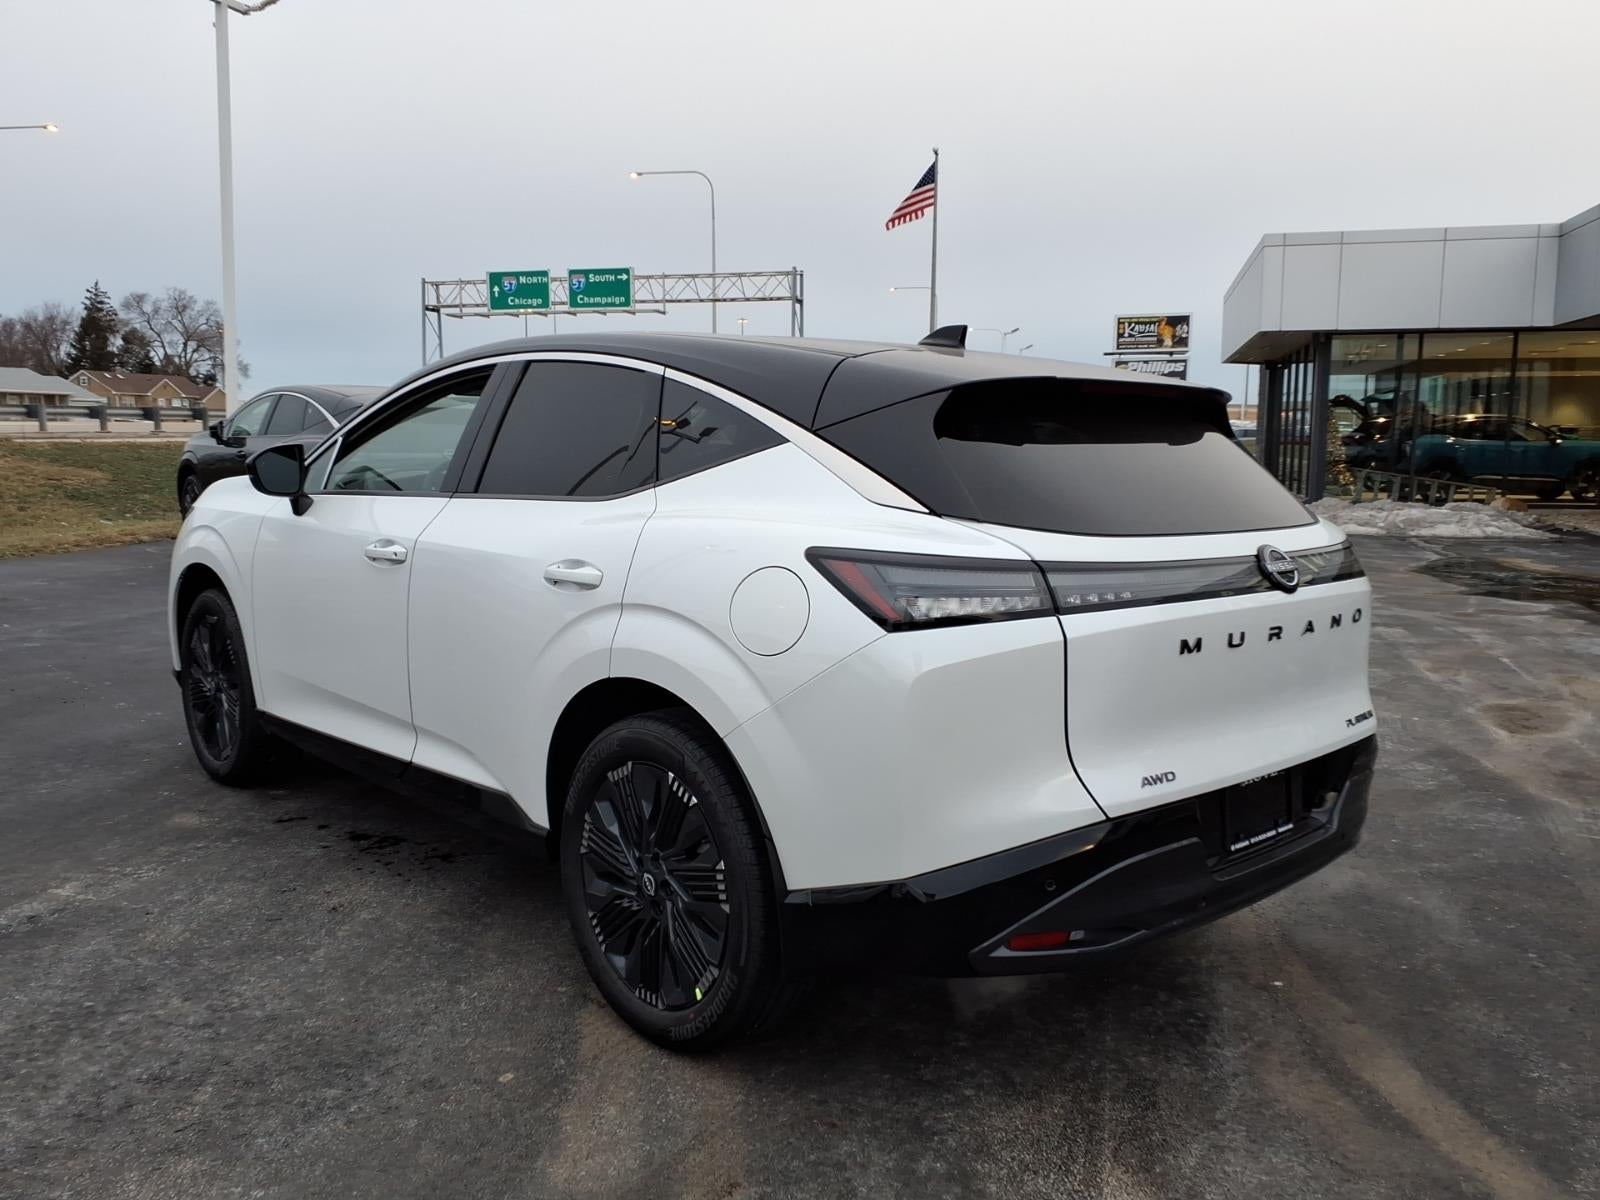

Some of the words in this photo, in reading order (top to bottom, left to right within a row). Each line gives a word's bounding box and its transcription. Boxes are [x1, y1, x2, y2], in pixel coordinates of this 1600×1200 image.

[503, 280, 516, 291] 57
[519, 276, 548, 284] NORTH
[570, 279, 586, 289] 57
[588, 274, 615, 282] SOUTH
[508, 296, 543, 306] Chicago
[577, 294, 626, 305] Champaign
[1127, 361, 1186, 374] Phillips
[1179, 608, 1362, 656] MURANO
[1140, 770, 1177, 789] AWD
